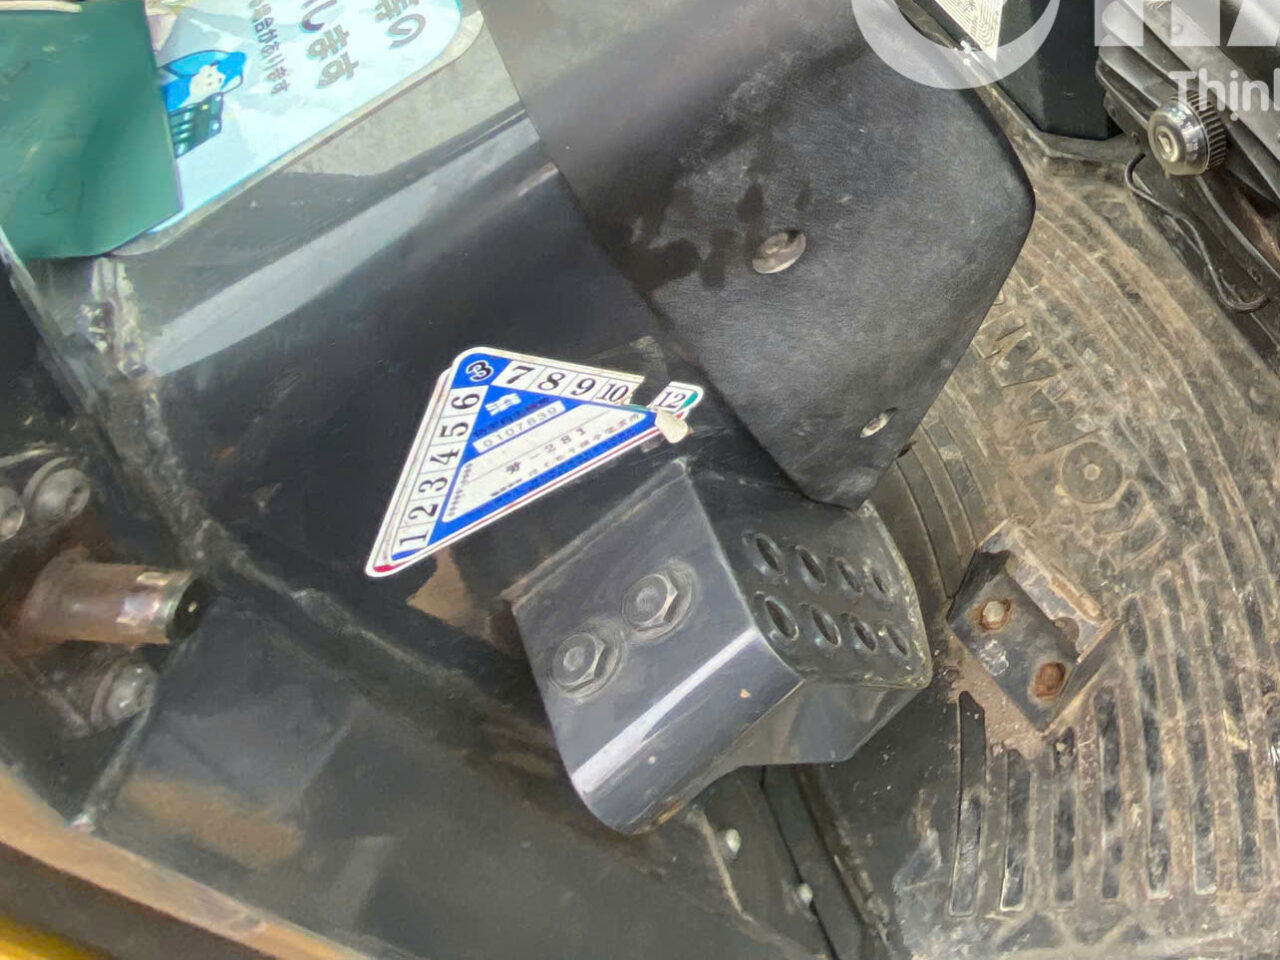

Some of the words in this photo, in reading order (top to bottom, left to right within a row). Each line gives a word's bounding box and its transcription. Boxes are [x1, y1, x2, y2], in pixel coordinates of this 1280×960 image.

[506, 365, 533, 384] 7
[538, 372, 566, 391] 8
[570, 377, 597, 396] 9
[596, 383, 630, 403] 10
[656, 390, 687, 409] 12
[451, 393, 480, 410] 6
[439, 421, 469, 438] 5
[430, 448, 460, 466] 4
[418, 476, 448, 493] 3
[407, 503, 438, 520] 2
[400, 529, 429, 547] 1
